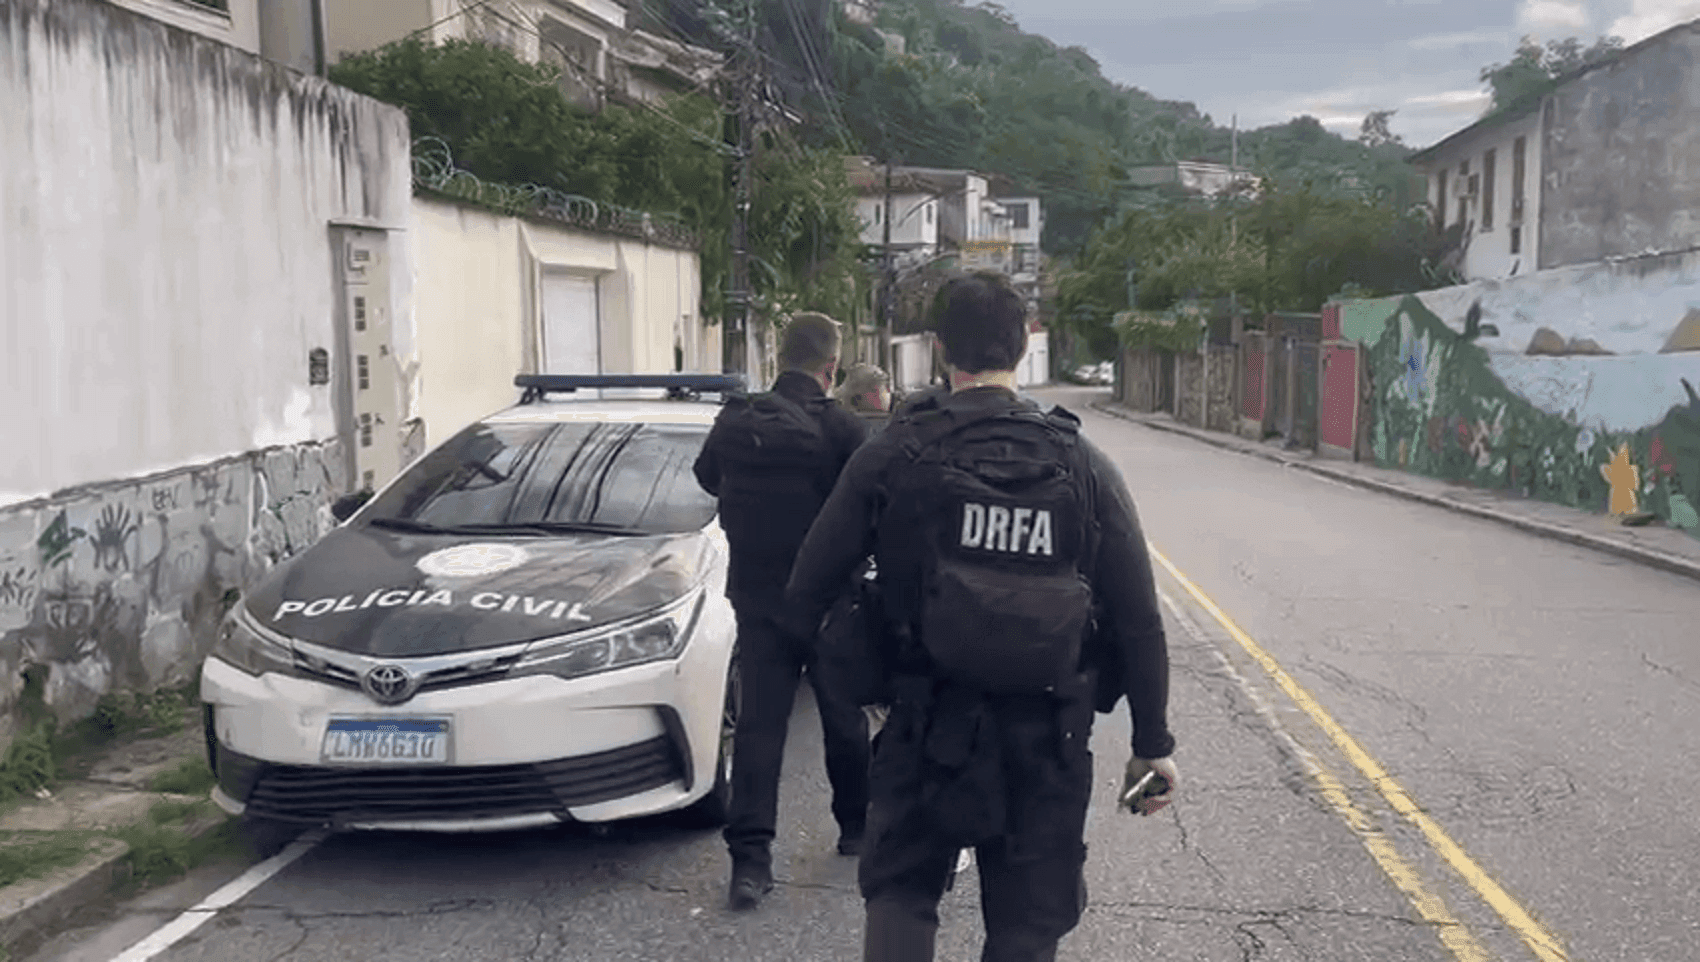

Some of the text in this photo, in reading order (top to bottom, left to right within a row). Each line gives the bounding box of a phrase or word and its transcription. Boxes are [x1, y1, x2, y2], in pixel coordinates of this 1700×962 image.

[960, 503, 1053, 555] DRFA
[273, 588, 592, 621] POLÍCIA CIVIL
